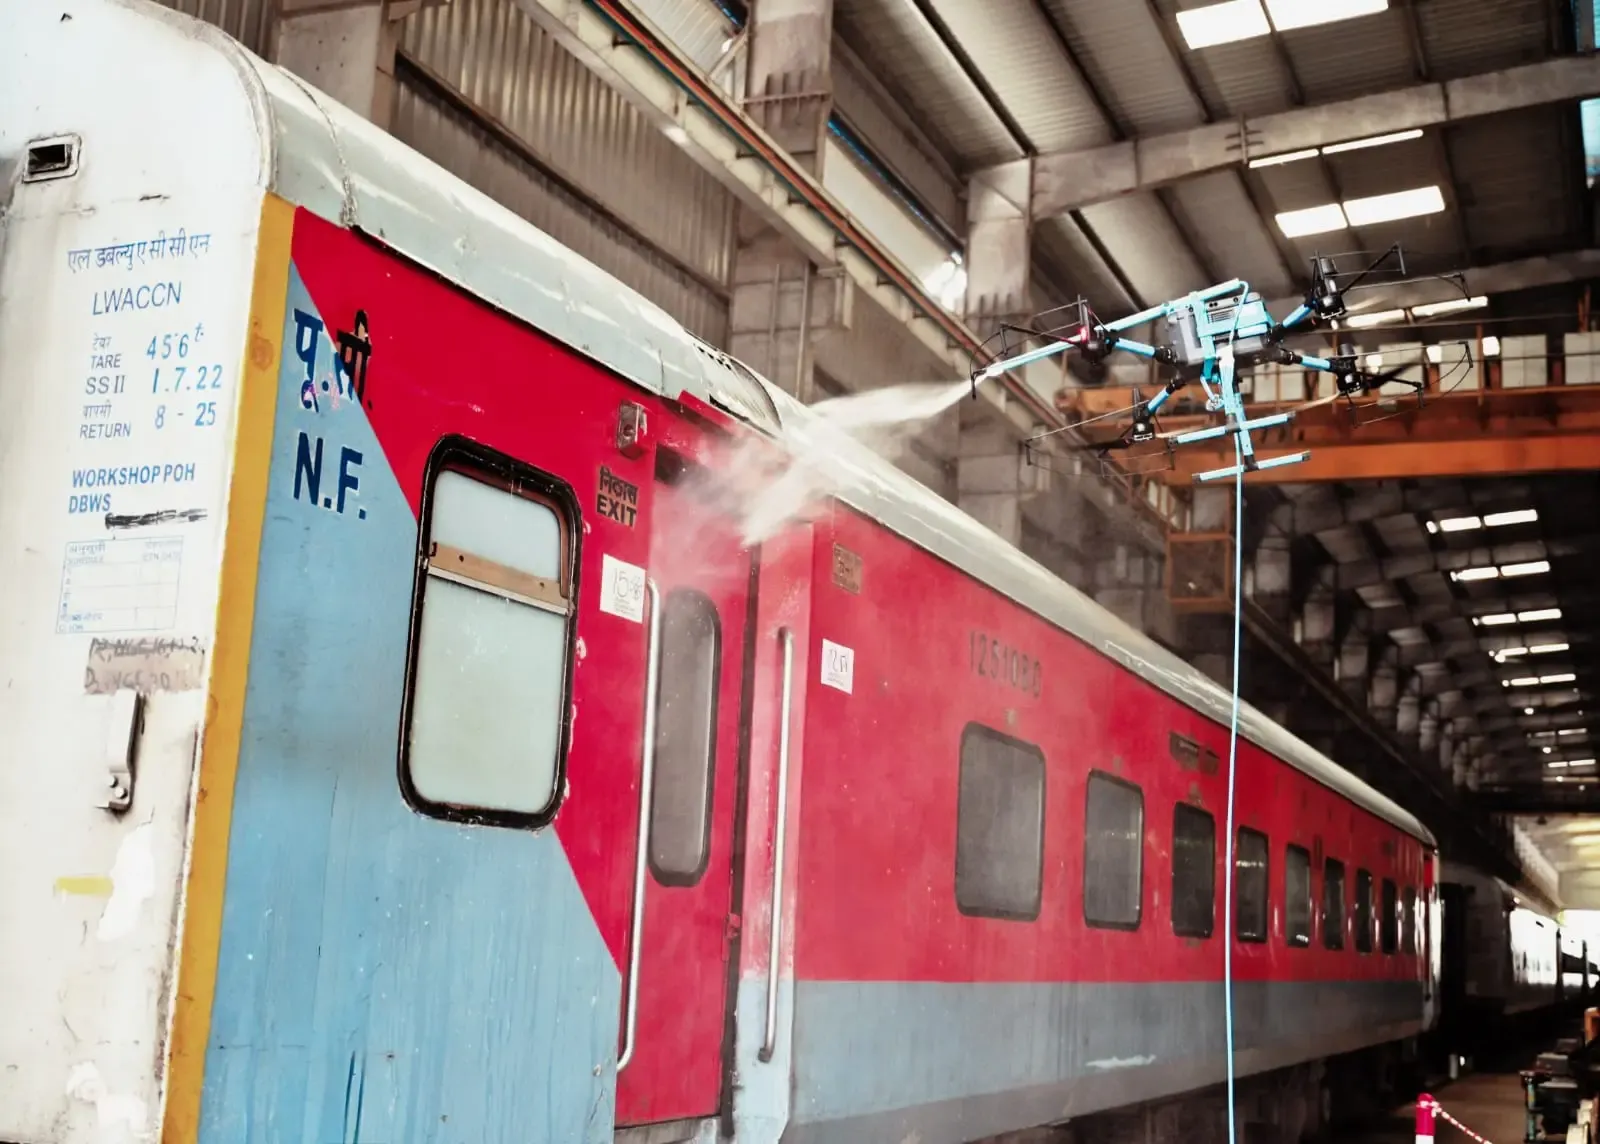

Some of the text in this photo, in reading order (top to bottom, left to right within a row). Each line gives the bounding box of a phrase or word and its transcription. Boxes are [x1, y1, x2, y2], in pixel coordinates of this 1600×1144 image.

[68, 249, 91, 273] एल
[92, 281, 182, 315] LWACCN
[90, 353, 122, 370] TARE
[85, 376, 110, 395] SS
[79, 422, 131, 439] RETURN
[72, 463, 196, 488] WORKSHOP POH
[293, 431, 367, 520] N.F.
[600, 466, 638, 505] निकास
[68, 493, 112, 514] DBWS
[597, 493, 637, 527] EXIT
